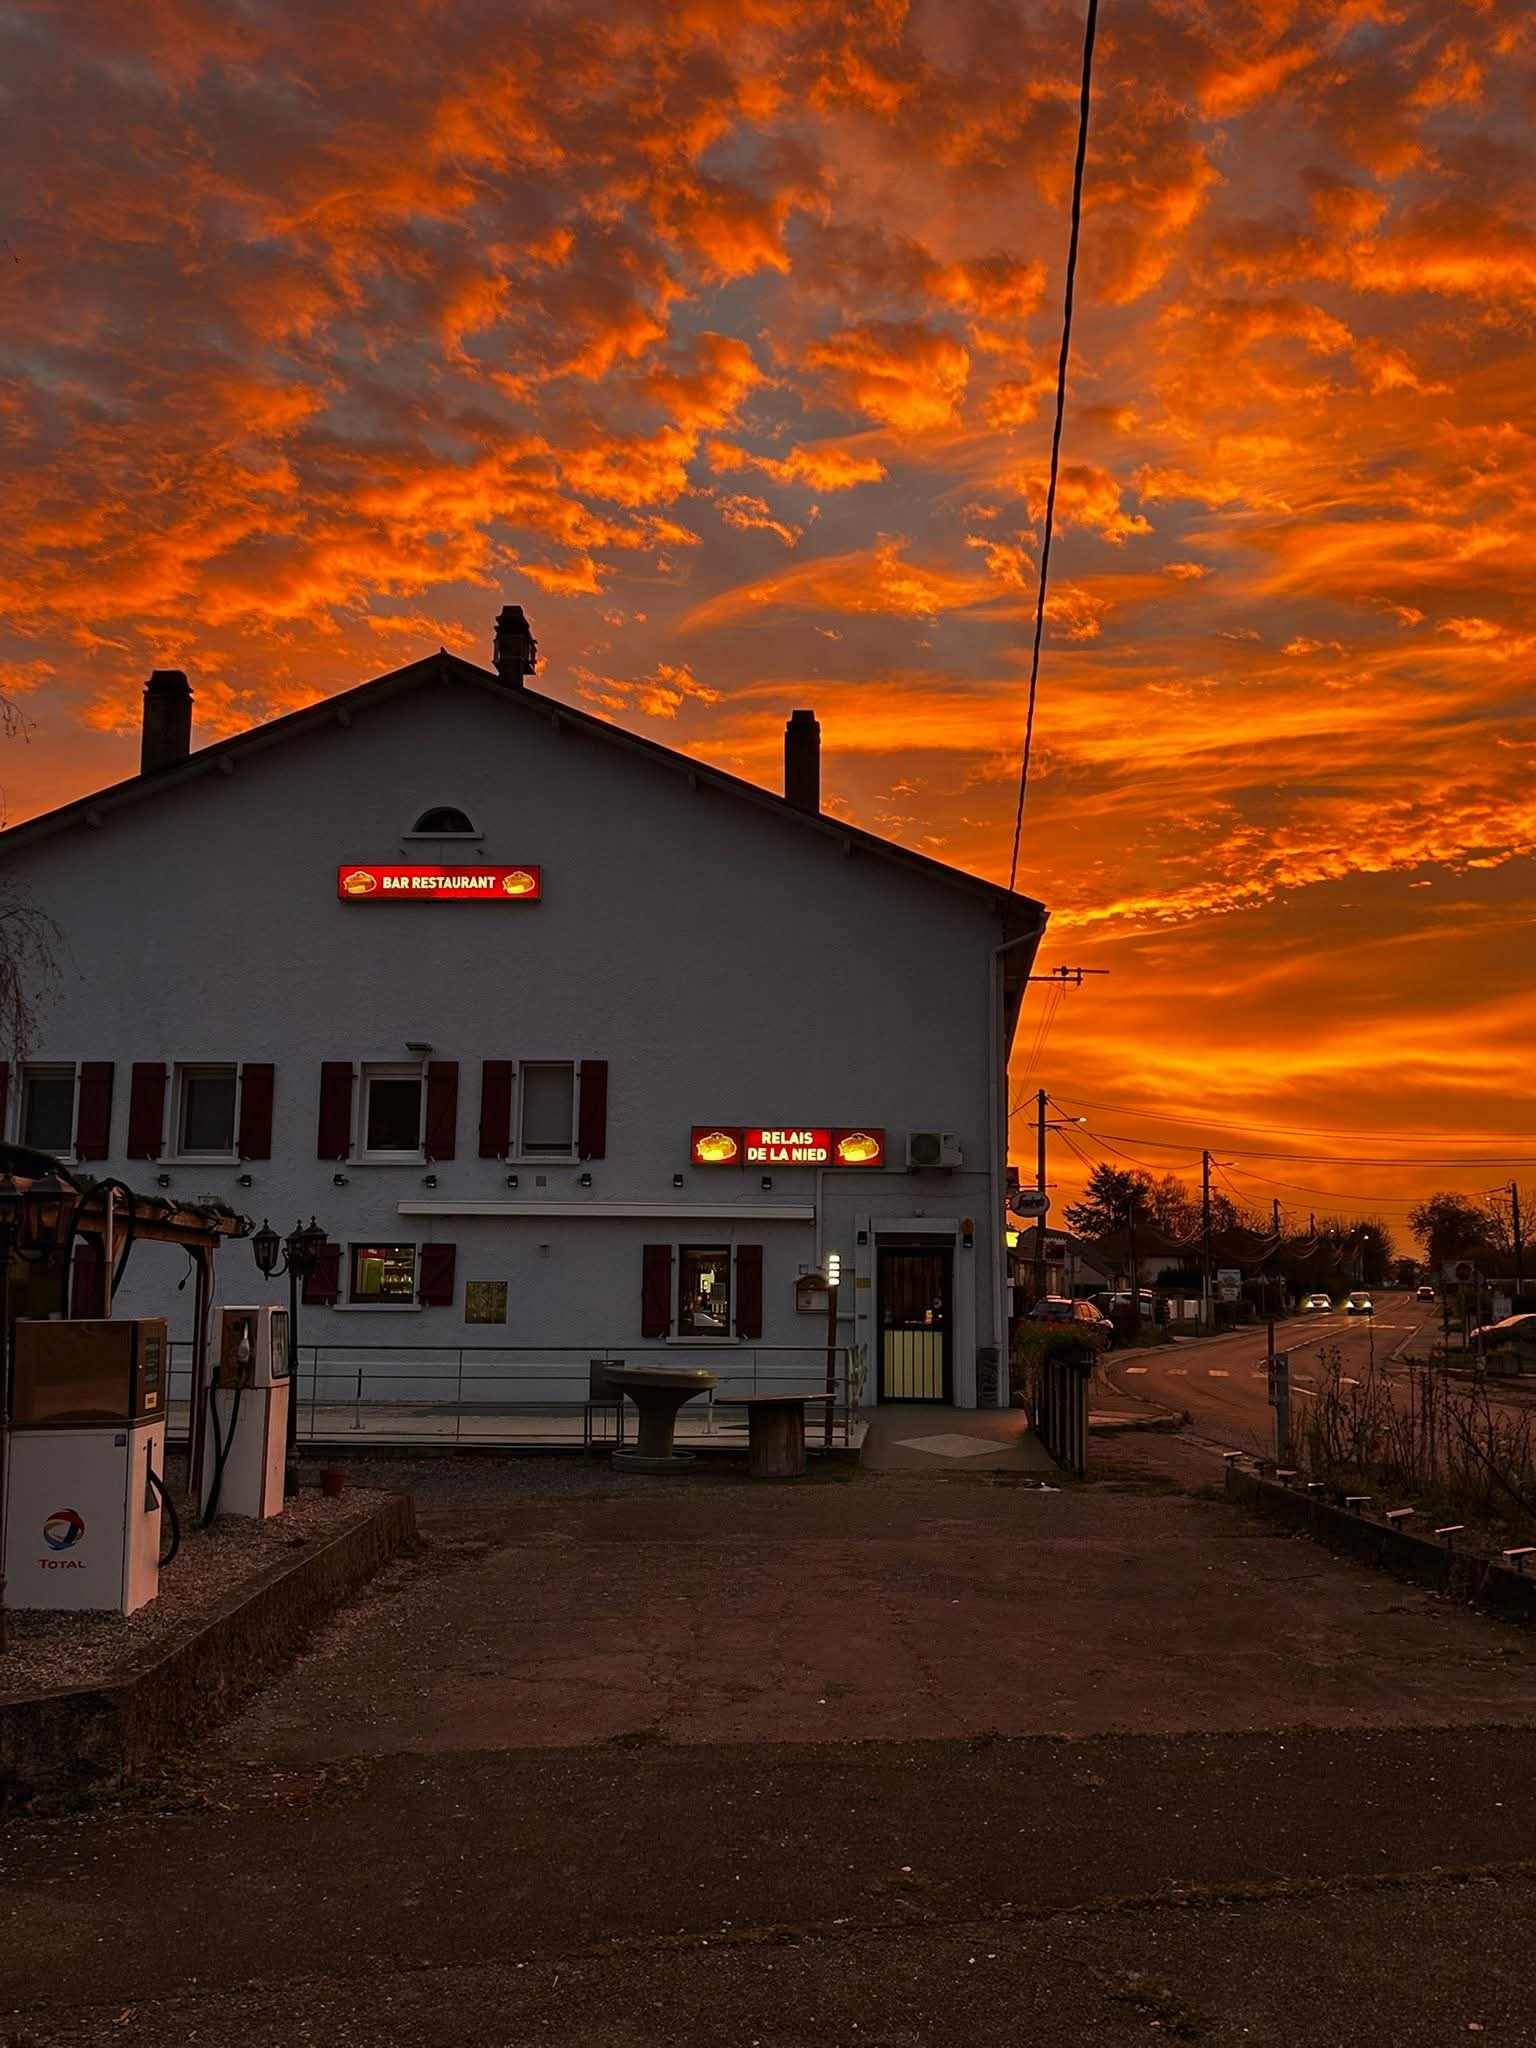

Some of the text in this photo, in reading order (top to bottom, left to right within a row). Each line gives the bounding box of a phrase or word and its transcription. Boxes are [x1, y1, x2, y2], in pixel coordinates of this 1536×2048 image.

[383, 876, 496, 889] BAR RESTAURANT
[761, 1131, 813, 1145] RELAIS
[747, 1148, 827, 1161] DE LA NIED
